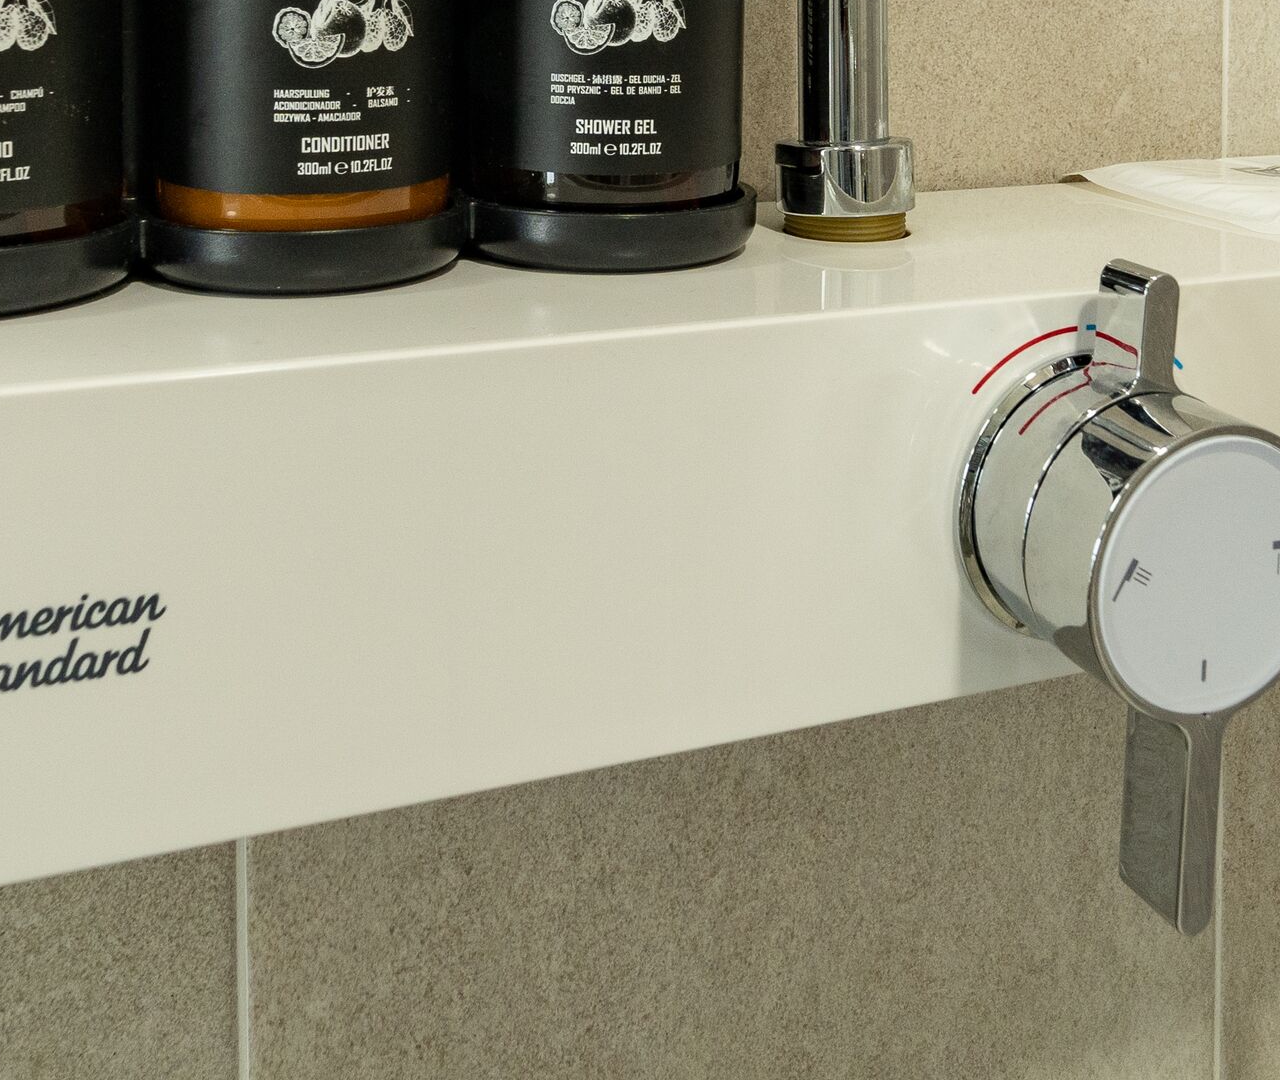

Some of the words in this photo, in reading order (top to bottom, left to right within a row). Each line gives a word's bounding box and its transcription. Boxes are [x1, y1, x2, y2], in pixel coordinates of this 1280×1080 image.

[550, 73, 586, 83] DUSCHGEL
[629, 75, 642, 84] GEL
[642, 75, 666, 84] DUCHA
[670, 74, 682, 83] ZEL
[550, 84, 564, 94] POD
[567, 85, 601, 95] PRYSZNIC
[610, 86, 624, 95] GEL
[626, 86, 636, 95] DE
[638, 86, 662, 95] BANHO
[669, 85, 682, 94] GEL
[550, 95, 576, 105] DOCCIA
[273, 101, 341, 111] ACONDICIONADOR
[318, 112, 361, 122] AMACIADOR
[575, 119, 631, 135] SHOWER
[634, 119, 657, 135] GEL
[301, 133, 390, 153] CONDITIONER
[570, 142, 601, 155] 300ml
[297, 162, 332, 176] 300ml
